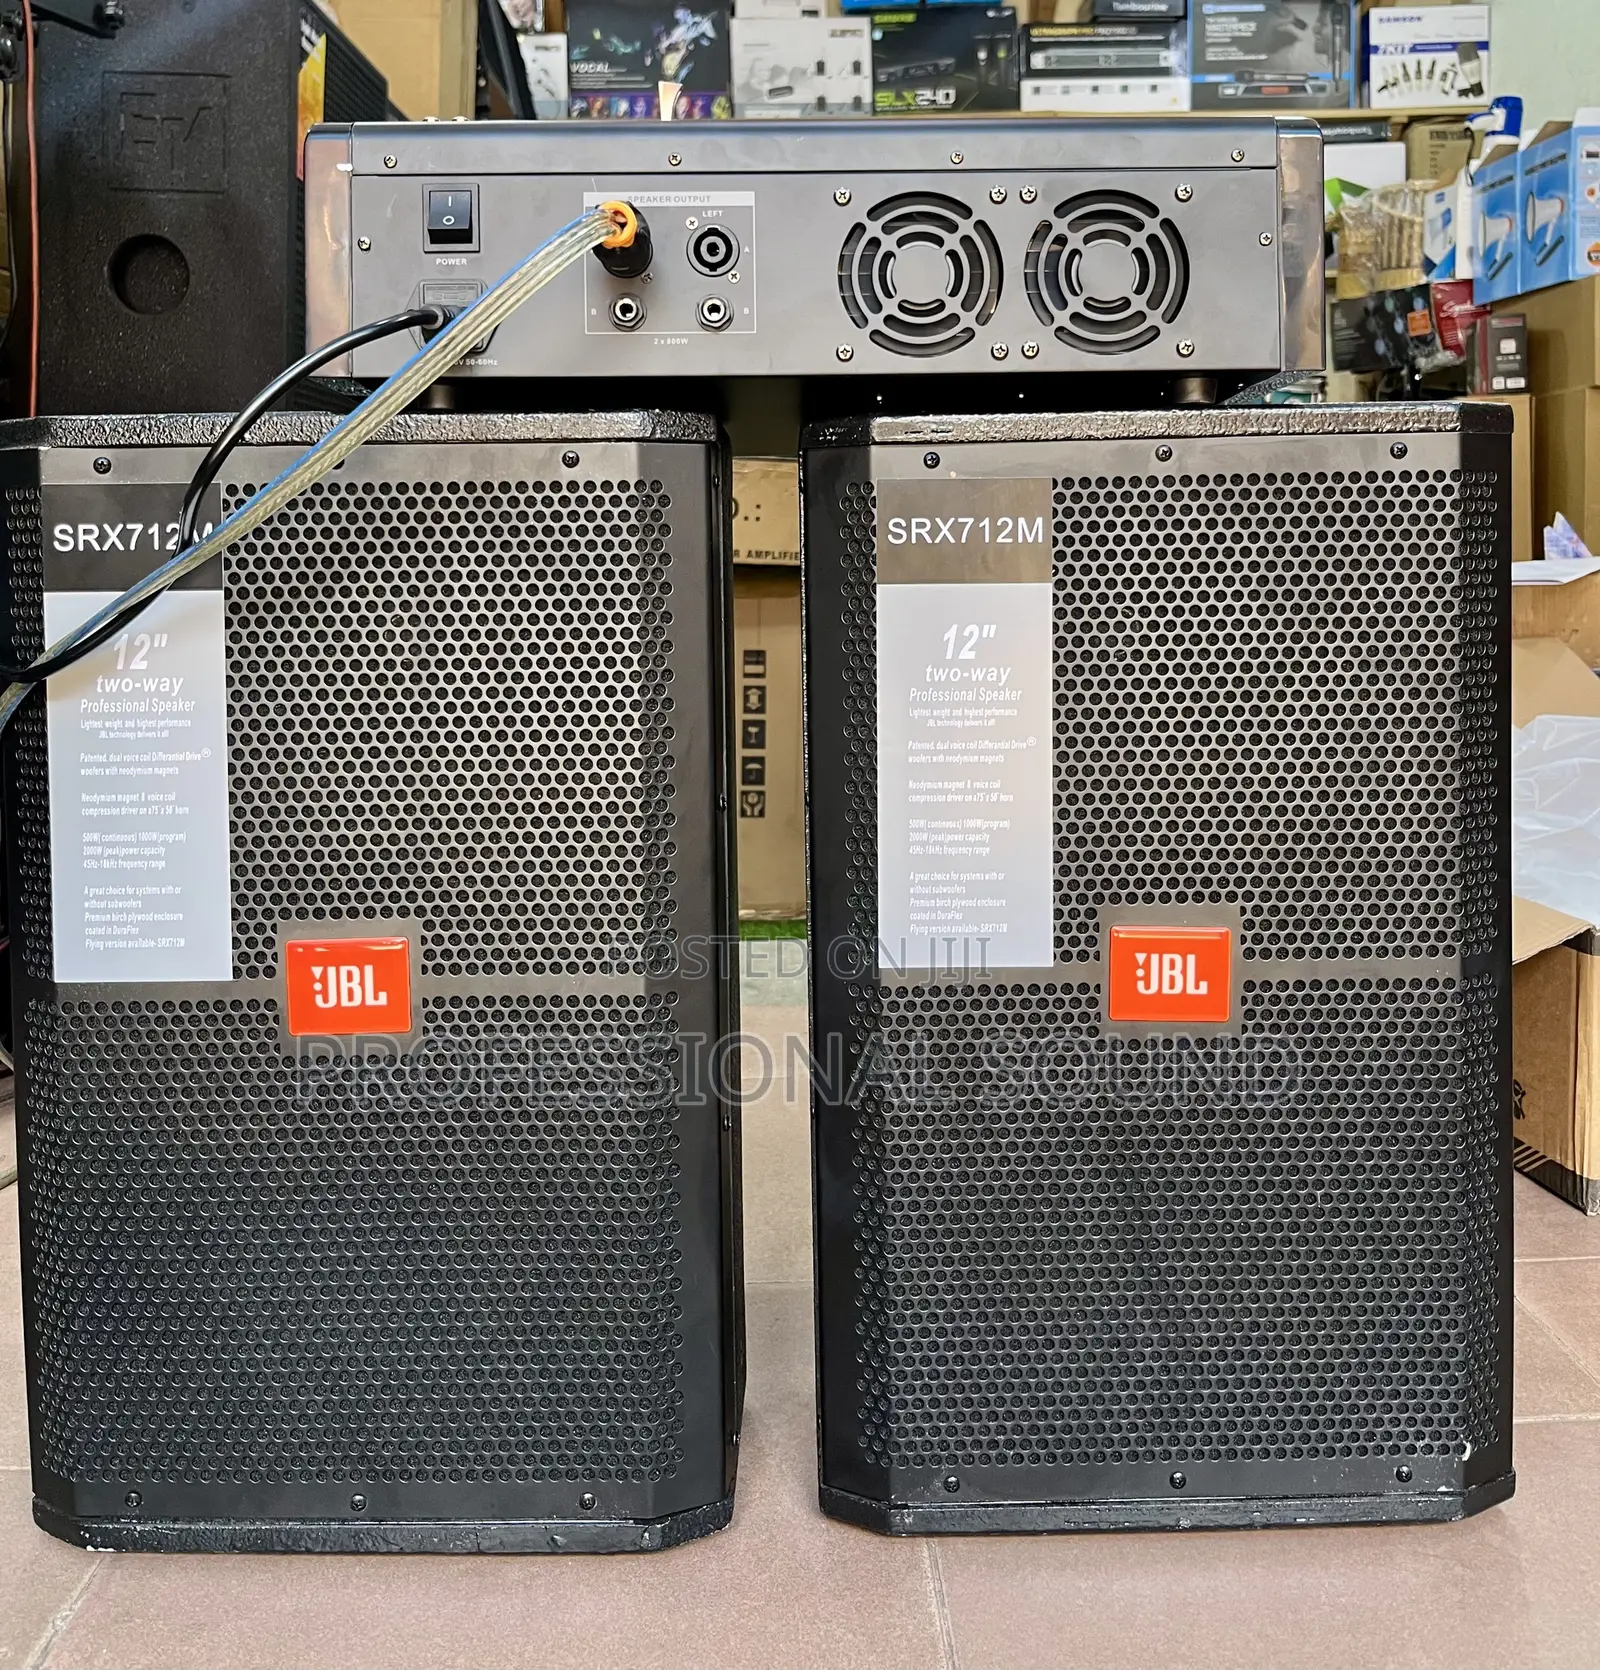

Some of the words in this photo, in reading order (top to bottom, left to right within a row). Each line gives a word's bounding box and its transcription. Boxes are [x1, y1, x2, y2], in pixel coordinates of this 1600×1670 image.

[569, 61, 611, 74] VOCAL
[627, 195, 671, 204] SPEAKER
[673, 195, 712, 203] OUTPUT
[702, 210, 723, 218] LEFT
[744, 246, 750, 254] A
[435, 258, 468, 266] POWER
[591, 308, 597, 316] B
[743, 307, 749, 315] B
[653, 337, 659, 345] 2
[665, 337, 689, 345] 800W
[465, 358, 498, 366] 50-60Hz
[887, 516, 1044, 545] SRX712M
[943, 624, 997, 660] 12"
[113, 633, 168, 670] 12"
[925, 664, 1011, 687] two-way
[96, 674, 184, 697] two-way
[909, 687, 977, 702] Professional
[978, 687, 1022, 704] Speaker
[80, 698, 149, 713] Professional
[151, 697, 196, 716] Speaker
[909, 707, 931, 719] Lightest
[932, 708, 950, 719] weight
[952, 708, 962, 716] and
[964, 707, 984, 719] highest
[984, 707, 1018, 718] performance
[81, 718, 103, 731] Lightest
[105, 719, 123, 730] weight
[125, 719, 135, 728] and
[137, 718, 157, 730] highest
[157, 718, 191, 730] performance
[936, 740, 949, 750] dual
[950, 740, 966, 750] voice
[966, 740, 977, 750] coil
[109, 752, 122, 762] dual
[123, 752, 139, 762] voice
[140, 752, 151, 761] coil
[932, 753, 944, 763] with
[979, 754, 1004, 765] magnets
[105, 765, 118, 775] with
[153, 766, 179, 777] magnets
[943, 780, 965, 791] magnet
[973, 780, 989, 789] voice
[989, 779, 1001, 788] coil
[117, 793, 139, 804] magnet
[147, 792, 164, 801] voice
[165, 791, 176, 801] coil
[909, 792, 946, 804] compression
[81, 806, 120, 818] compression
[965, 832, 990, 843] capacity
[140, 845, 166, 856] capacity
[943, 845, 972, 857] frequency
[973, 846, 990, 857] range
[119, 859, 148, 870] frequency
[148, 860, 166, 870] range
[915, 872, 930, 883] great
[930, 871, 950, 881] choice
[950, 871, 959, 880] for
[960, 872, 984, 883] systems
[985, 871, 997, 880] with
[89, 886, 105, 898] great
[105, 886, 125, 895] choice
[126, 885, 135, 895] for
[136, 886, 160, 896] systems
[161, 885, 174, 895] with
[909, 884, 932, 894] without
[932, 884, 966, 894] subwoofers
[84, 899, 107, 909] without
[107, 898, 142, 908] subwoofers
[909, 898, 936, 907] Premium
[936, 898, 951, 907] birch
[951, 898, 977, 909] plywood
[977, 898, 1006, 907] enclosure
[84, 912, 111, 922] Premium
[111, 912, 127, 921] birch
[127, 911, 154, 923] plywood
[154, 911, 183, 921] enclosure
[909, 911, 930, 920] coated
[937, 910, 963, 920] DuraFlex
[85, 925, 106, 935] coated
[112, 925, 140, 935] DuraFlex
[910, 923, 929, 936] Flying
[929, 924, 951, 933] version
[85, 938, 105, 951] Flying
[105, 938, 127, 948] version
[1134, 951, 1208, 995] JBL
[311, 965, 388, 1008] JBL
